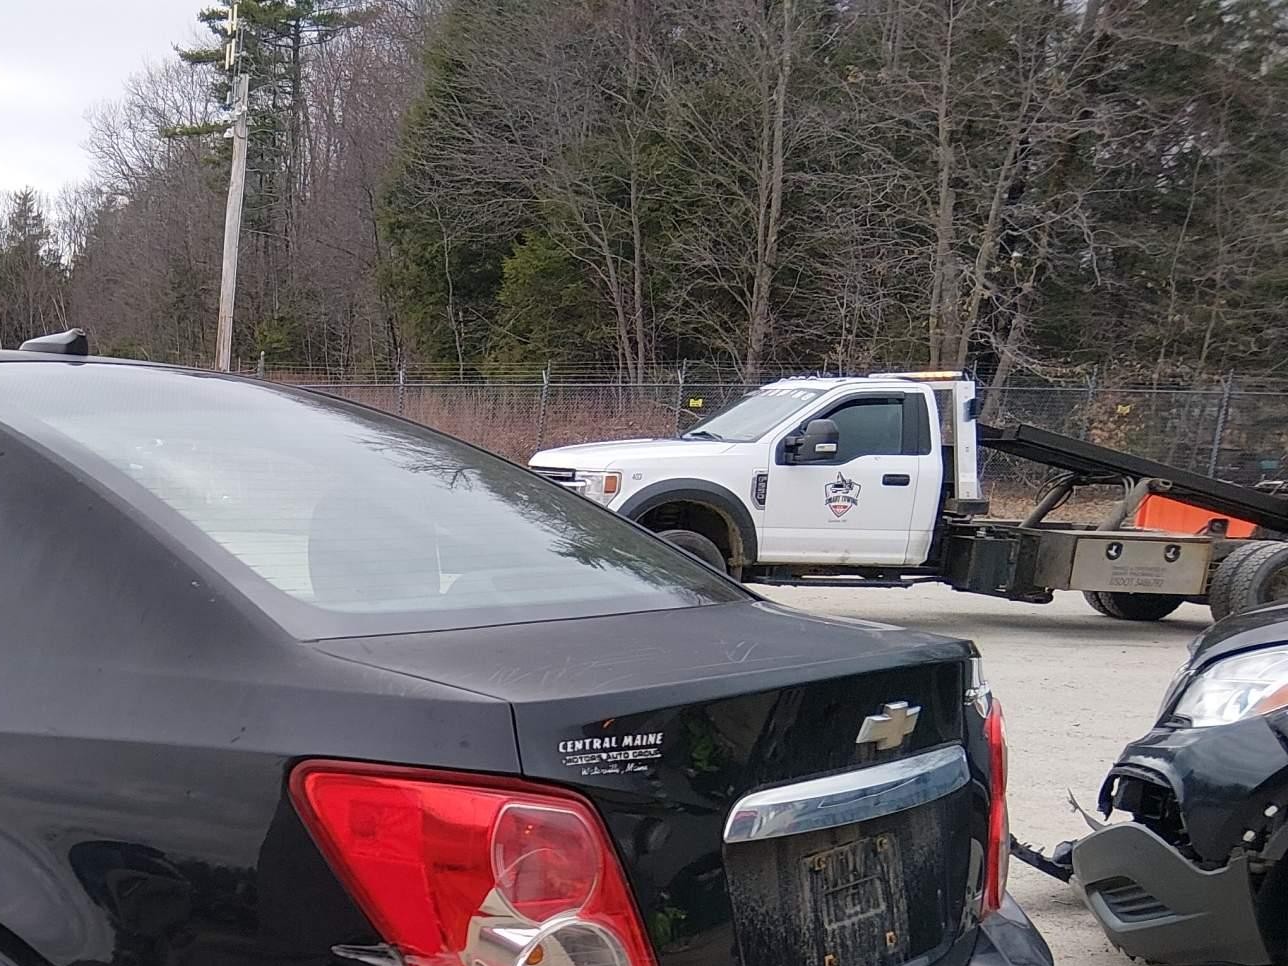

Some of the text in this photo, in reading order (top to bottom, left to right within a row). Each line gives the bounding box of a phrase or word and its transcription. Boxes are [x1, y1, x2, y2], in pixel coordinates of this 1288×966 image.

[558, 732, 664, 753] CENTRAL MAINE
[566, 753, 602, 765] MOTORS
[605, 750, 630, 761] AUTO
